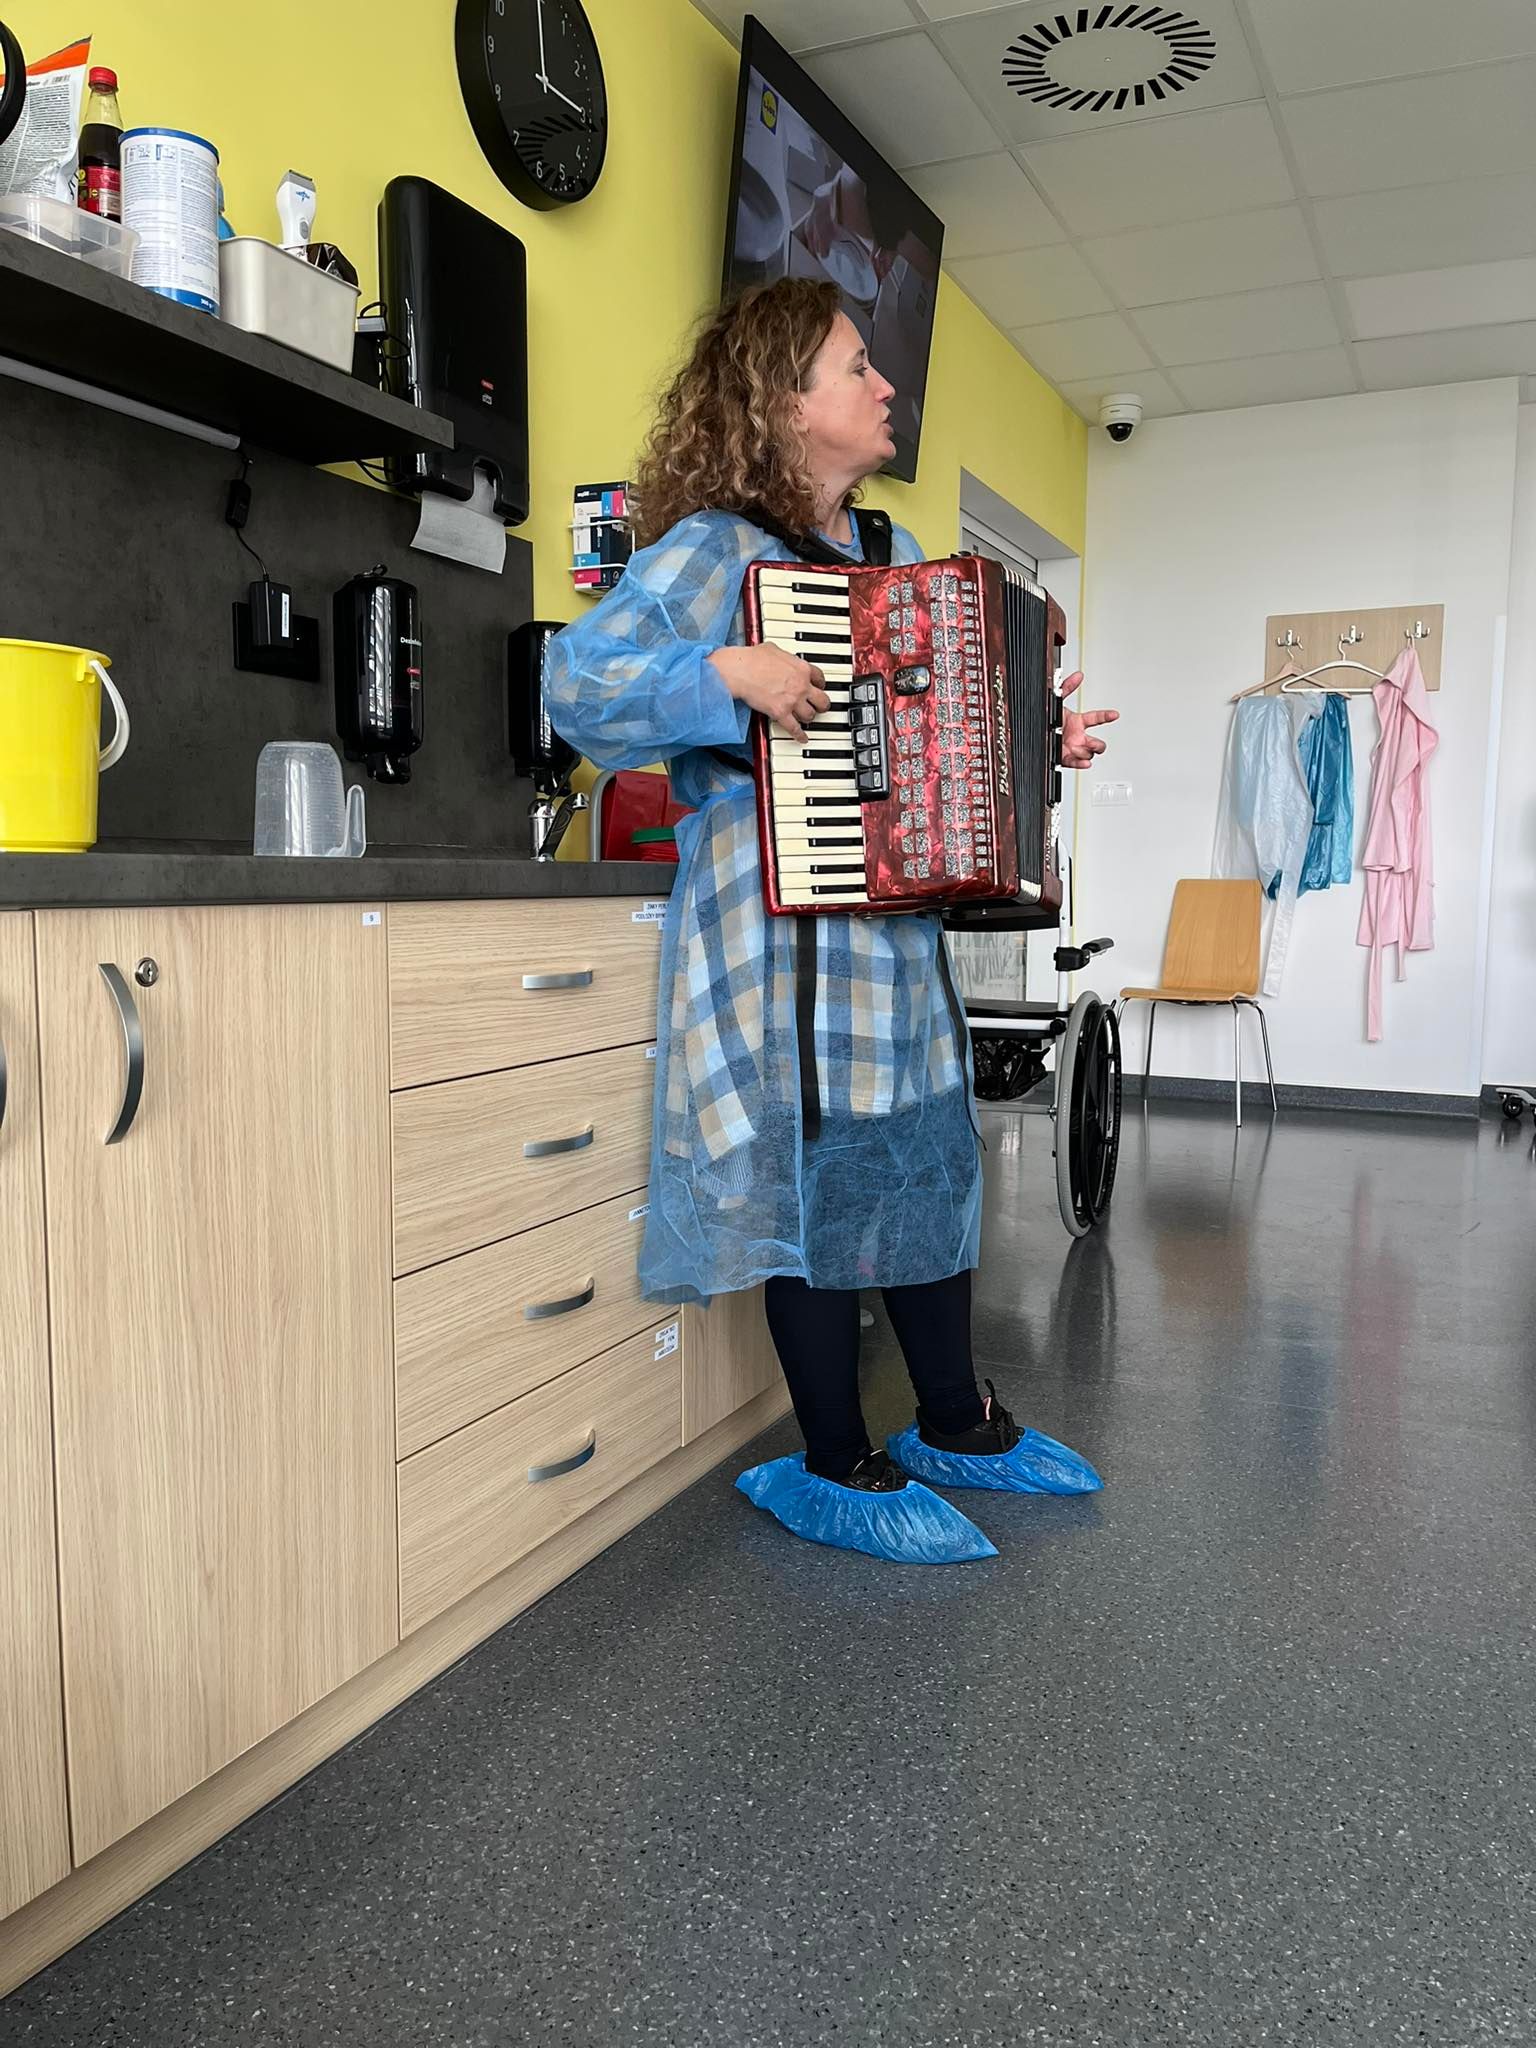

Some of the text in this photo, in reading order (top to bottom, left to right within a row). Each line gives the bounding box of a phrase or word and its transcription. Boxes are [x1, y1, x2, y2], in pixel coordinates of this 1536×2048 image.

[487, 35, 495, 53] 9
[574, 59, 582, 78] 2
[512, 129, 520, 147] 7
[536, 160, 543, 179] 6
[558, 162, 566, 181] 5
